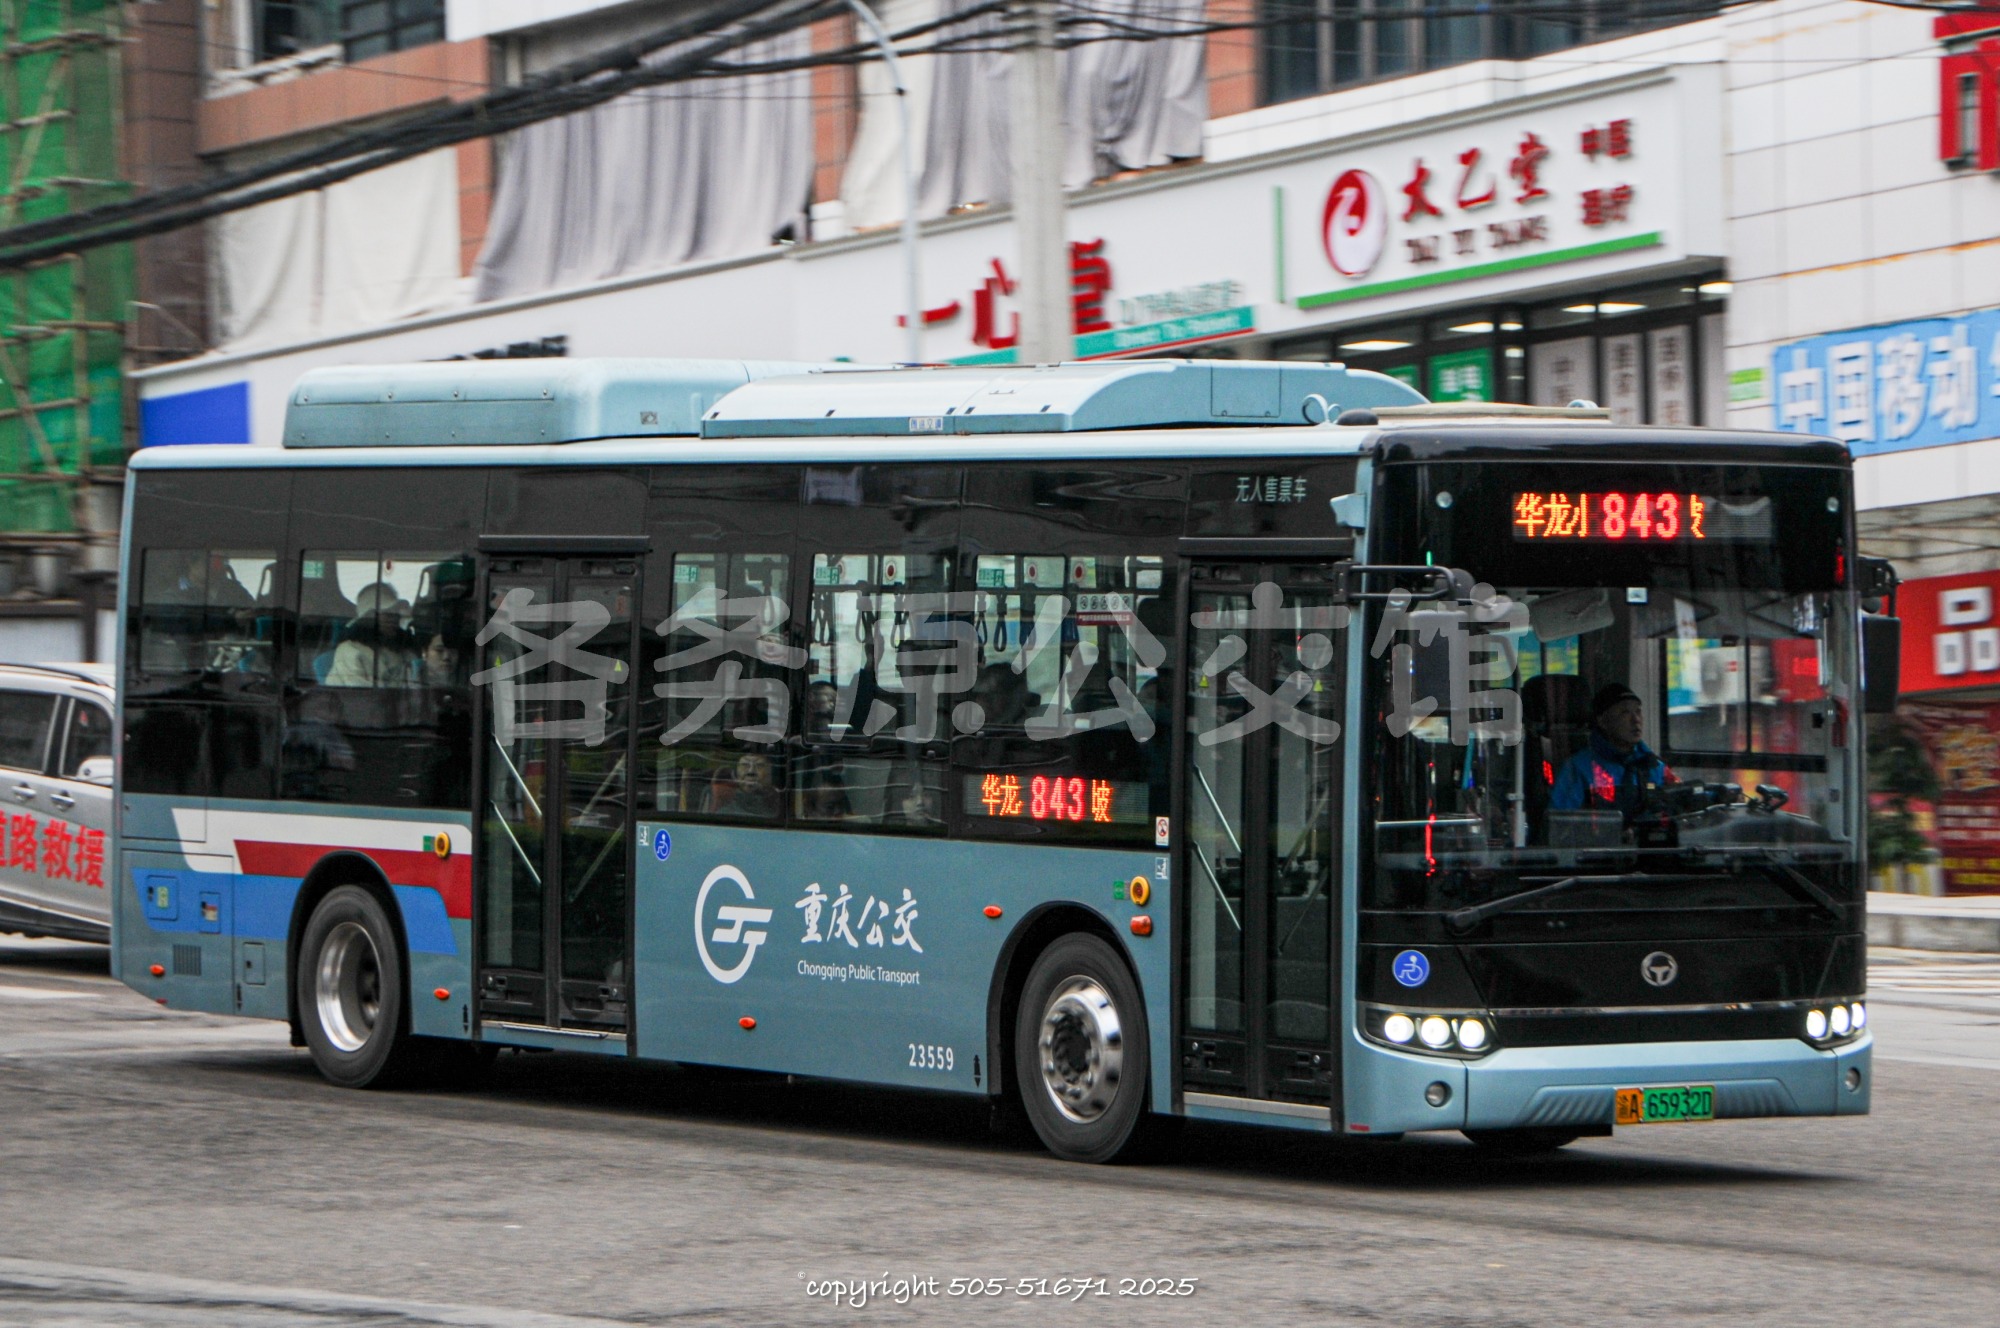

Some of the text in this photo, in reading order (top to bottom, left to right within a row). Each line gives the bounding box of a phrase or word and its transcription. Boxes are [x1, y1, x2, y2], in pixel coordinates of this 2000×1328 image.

[1780, 323, 2000, 442] 中国移动
[1235, 475, 1308, 503] 无人售票车
[1515, 493, 1588, 538] 华龙
[1602, 492, 1679, 539] 843
[1030, 775, 1086, 822] 843
[0, 810, 104, 888] 路救援
[795, 882, 923, 953] 重庆公交
[797, 960, 920, 986] Chongqing Public Transport
[908, 1043, 954, 1070] 23559
